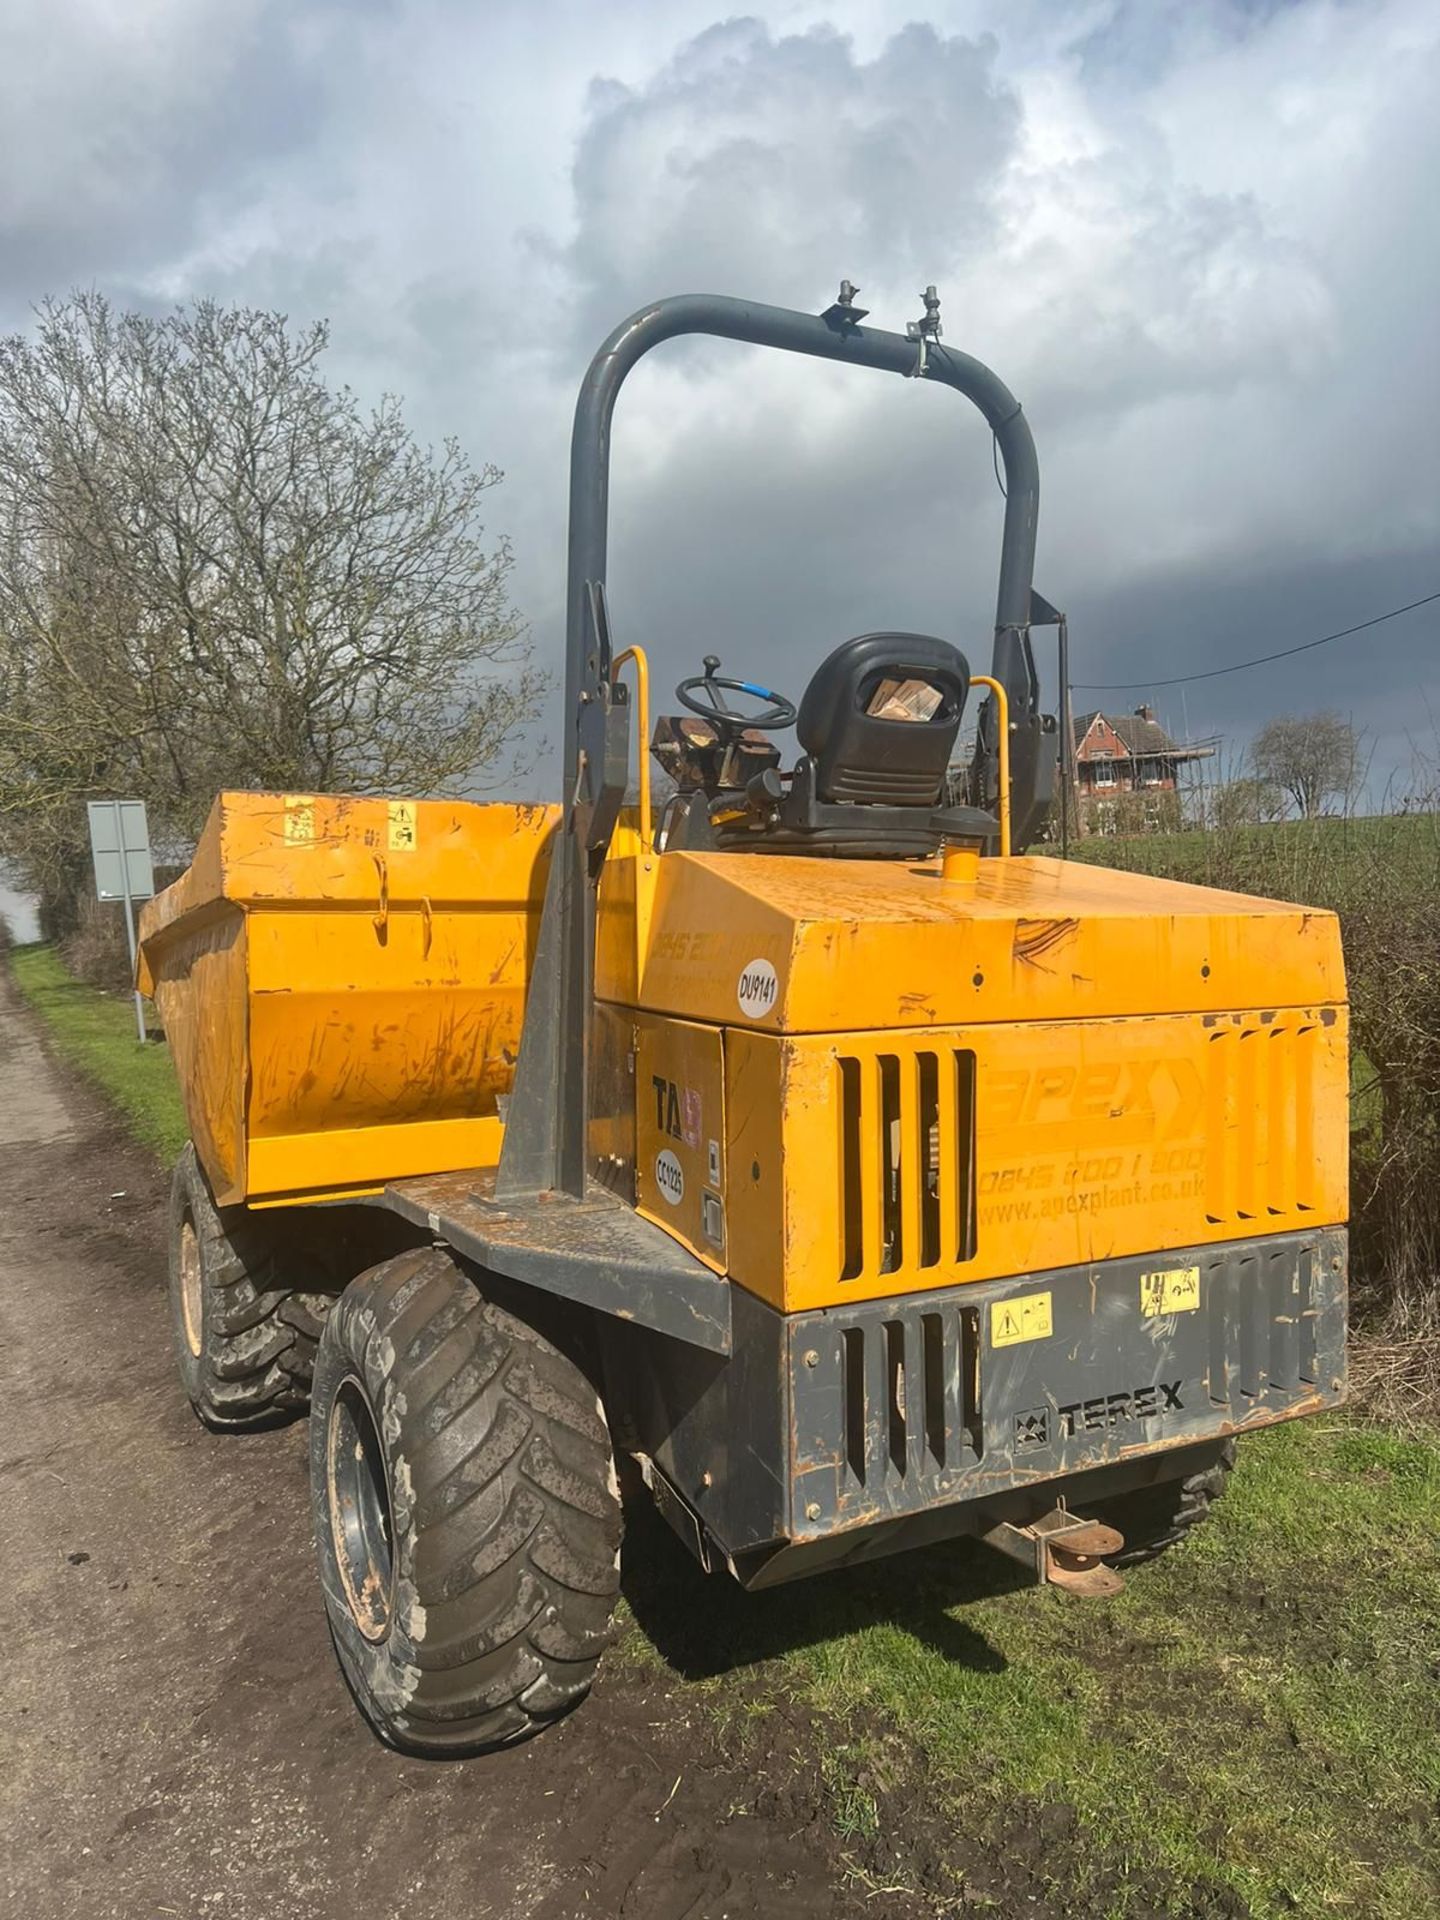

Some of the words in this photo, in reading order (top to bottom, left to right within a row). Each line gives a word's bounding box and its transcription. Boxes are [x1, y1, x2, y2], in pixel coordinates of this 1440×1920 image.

[739, 973, 776, 1003] DU9141
[658, 1159, 682, 1196] CC1225
[978, 1164, 1056, 1195] 0845
[978, 1172, 1206, 1226] www.apexplant.co.uk
[1058, 1380, 1185, 1436] TEREX
